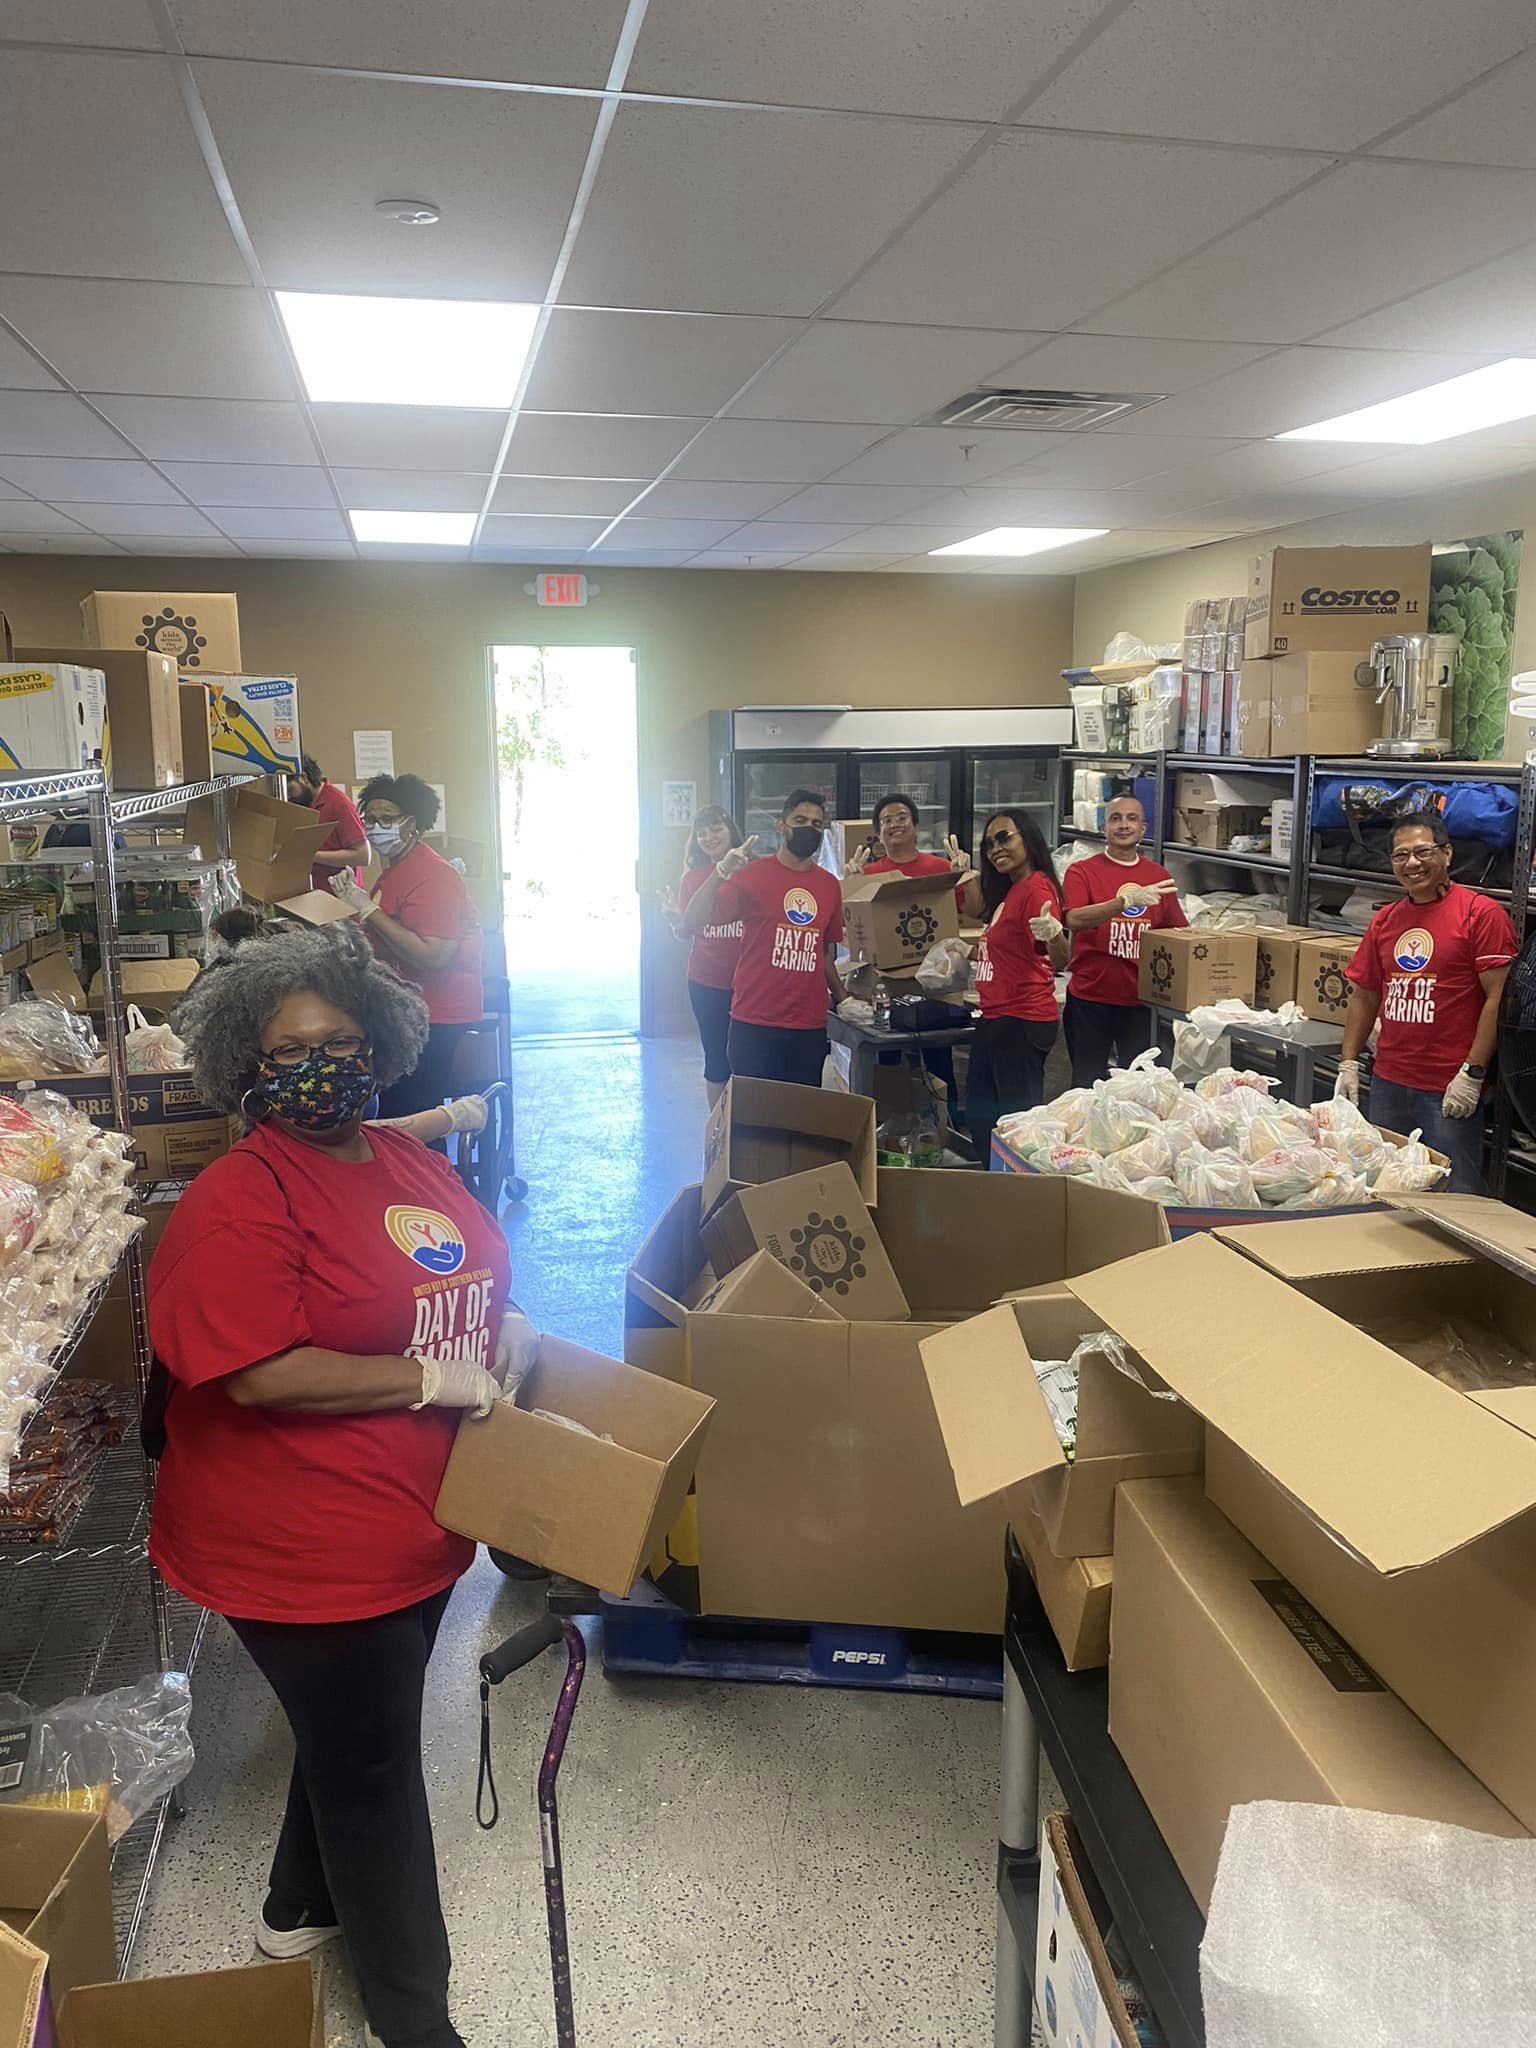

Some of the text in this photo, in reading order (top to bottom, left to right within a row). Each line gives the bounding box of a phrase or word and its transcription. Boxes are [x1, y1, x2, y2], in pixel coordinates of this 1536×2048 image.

[544, 576, 580, 603] EXIT
[1301, 587, 1400, 607] COSTCO
[1275, 639, 1287, 650] 40
[13, 673, 42, 684] CLASS
[247, 682, 286, 692] CLASS EXTRA
[775, 927, 801, 950] DAY
[803, 931, 820, 953] OF
[1110, 922, 1135, 941] DAY
[771, 947, 817, 972] CARING
[1387, 977, 1437, 1000] DAY OF
[1384, 997, 1436, 1023] CARING
[411, 1278, 494, 1346] DAY OF
[832, 1650, 887, 1665] PEPSI
